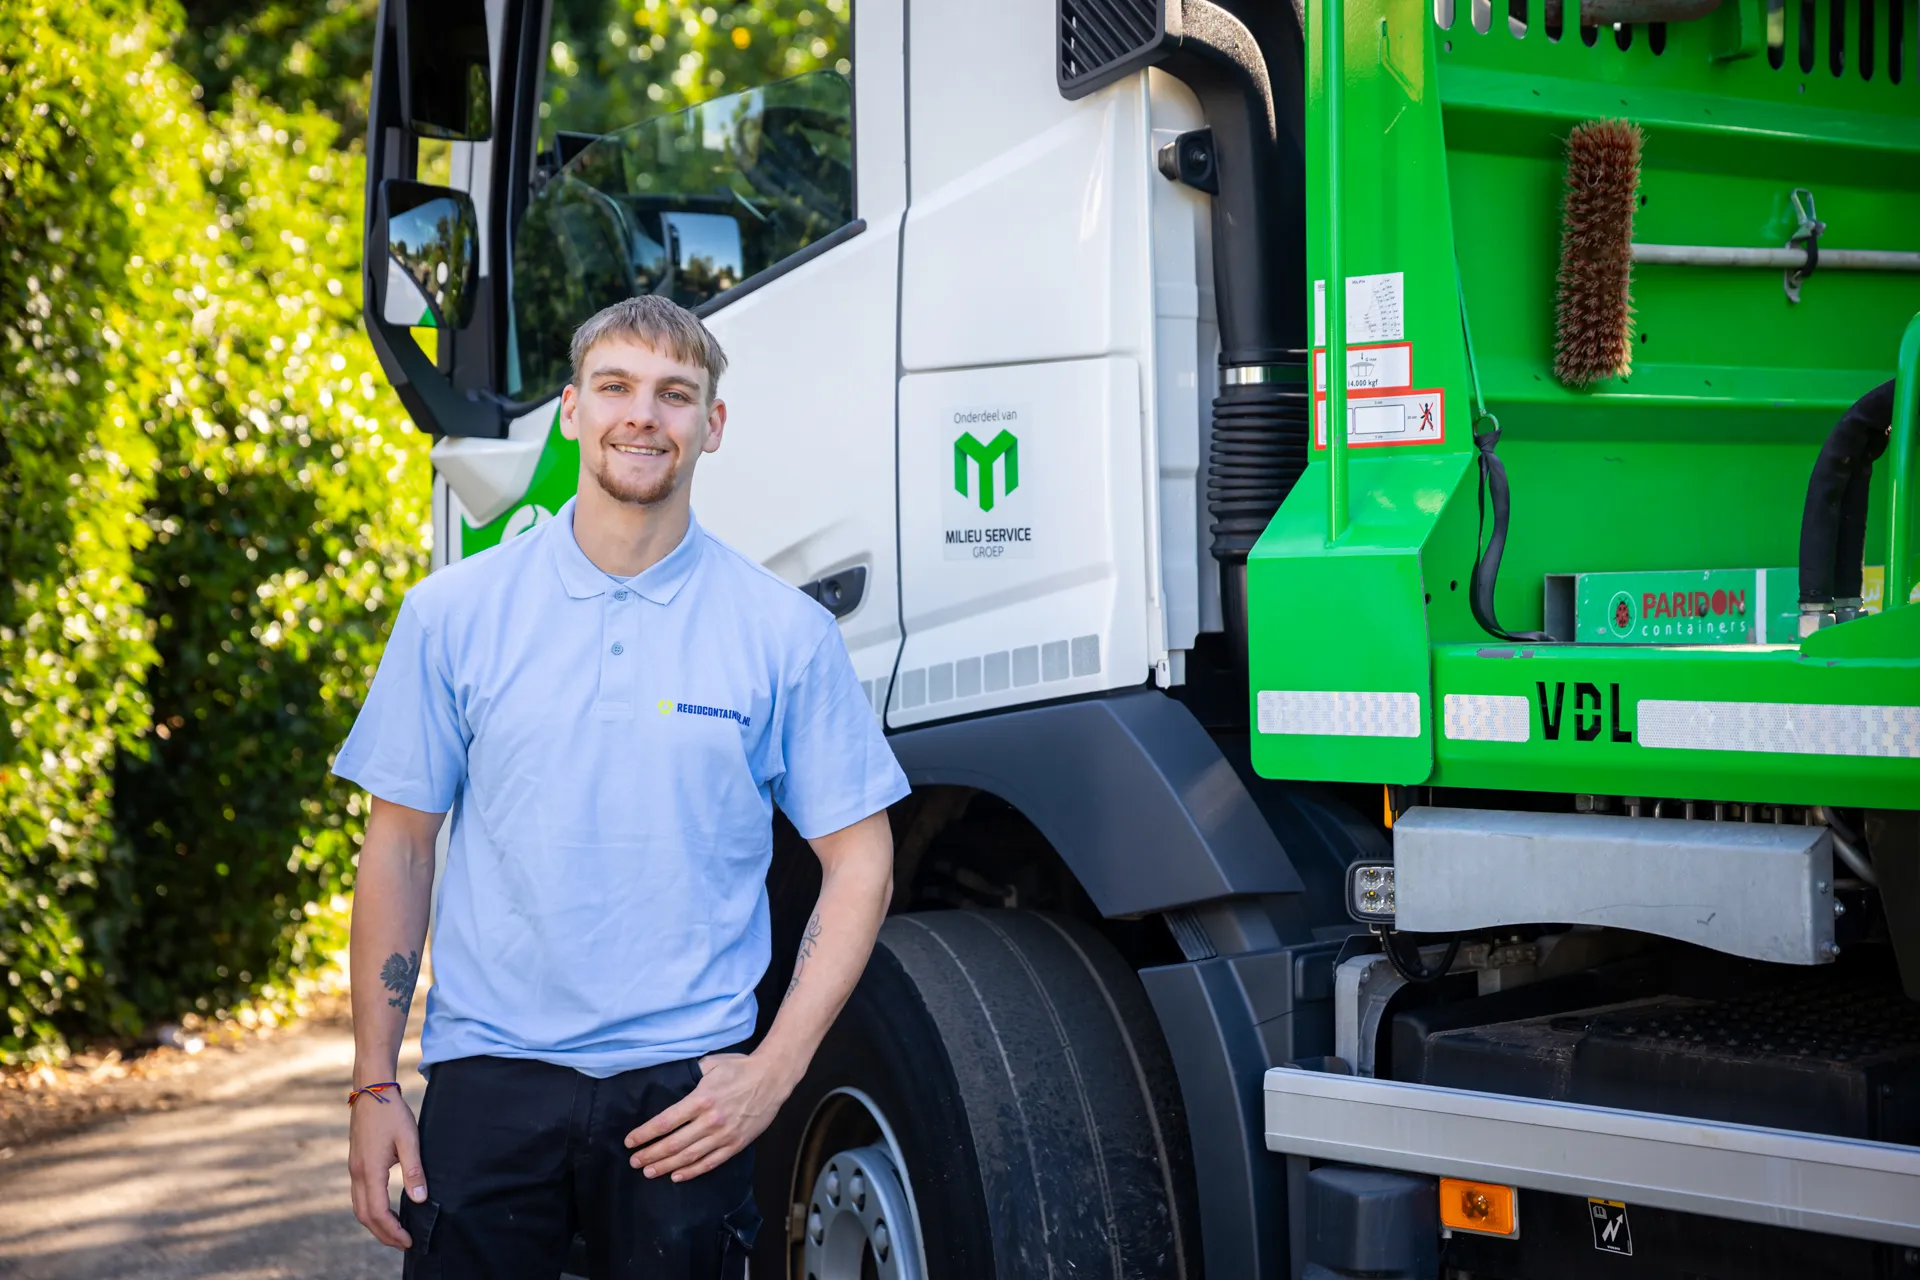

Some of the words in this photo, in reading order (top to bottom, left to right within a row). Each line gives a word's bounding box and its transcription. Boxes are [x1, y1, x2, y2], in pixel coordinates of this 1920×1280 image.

[1368, 378, 1379, 388] kgf
[954, 409, 1000, 424] Onderdeel
[1001, 410, 1017, 421] van
[945, 529, 982, 544] MILIEU
[985, 527, 1031, 542] SERVICE
[972, 546, 1004, 558] GROEP
[1642, 589, 1745, 619] PARIDON
[1642, 620, 1746, 637] containers
[1536, 681, 1632, 743] VDL
